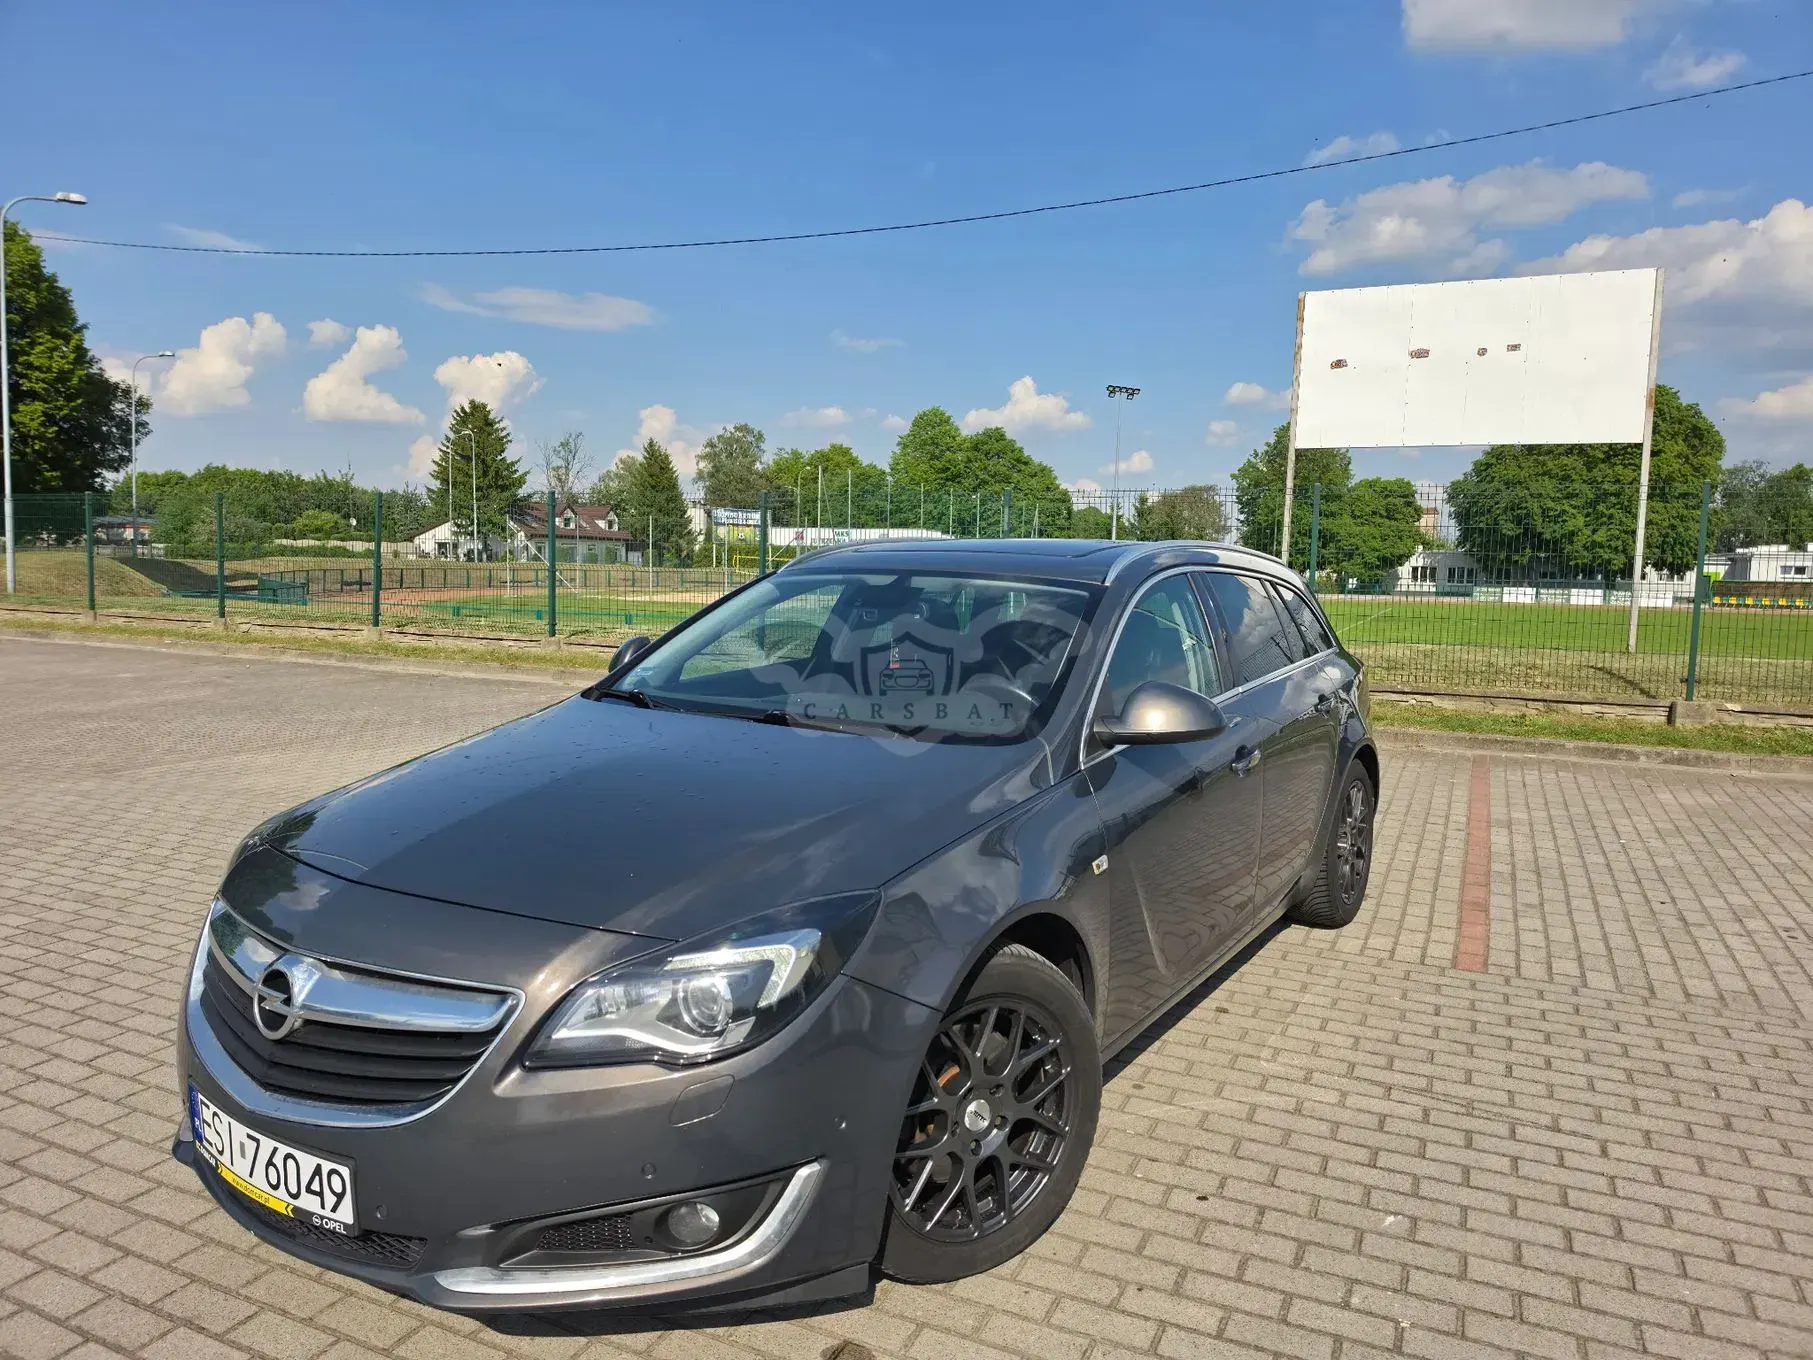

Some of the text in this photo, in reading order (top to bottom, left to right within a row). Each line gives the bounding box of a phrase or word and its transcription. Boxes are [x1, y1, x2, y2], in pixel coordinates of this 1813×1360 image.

[200, 1099, 347, 1214] ESI 76049
[322, 1218, 347, 1234] OPEL
